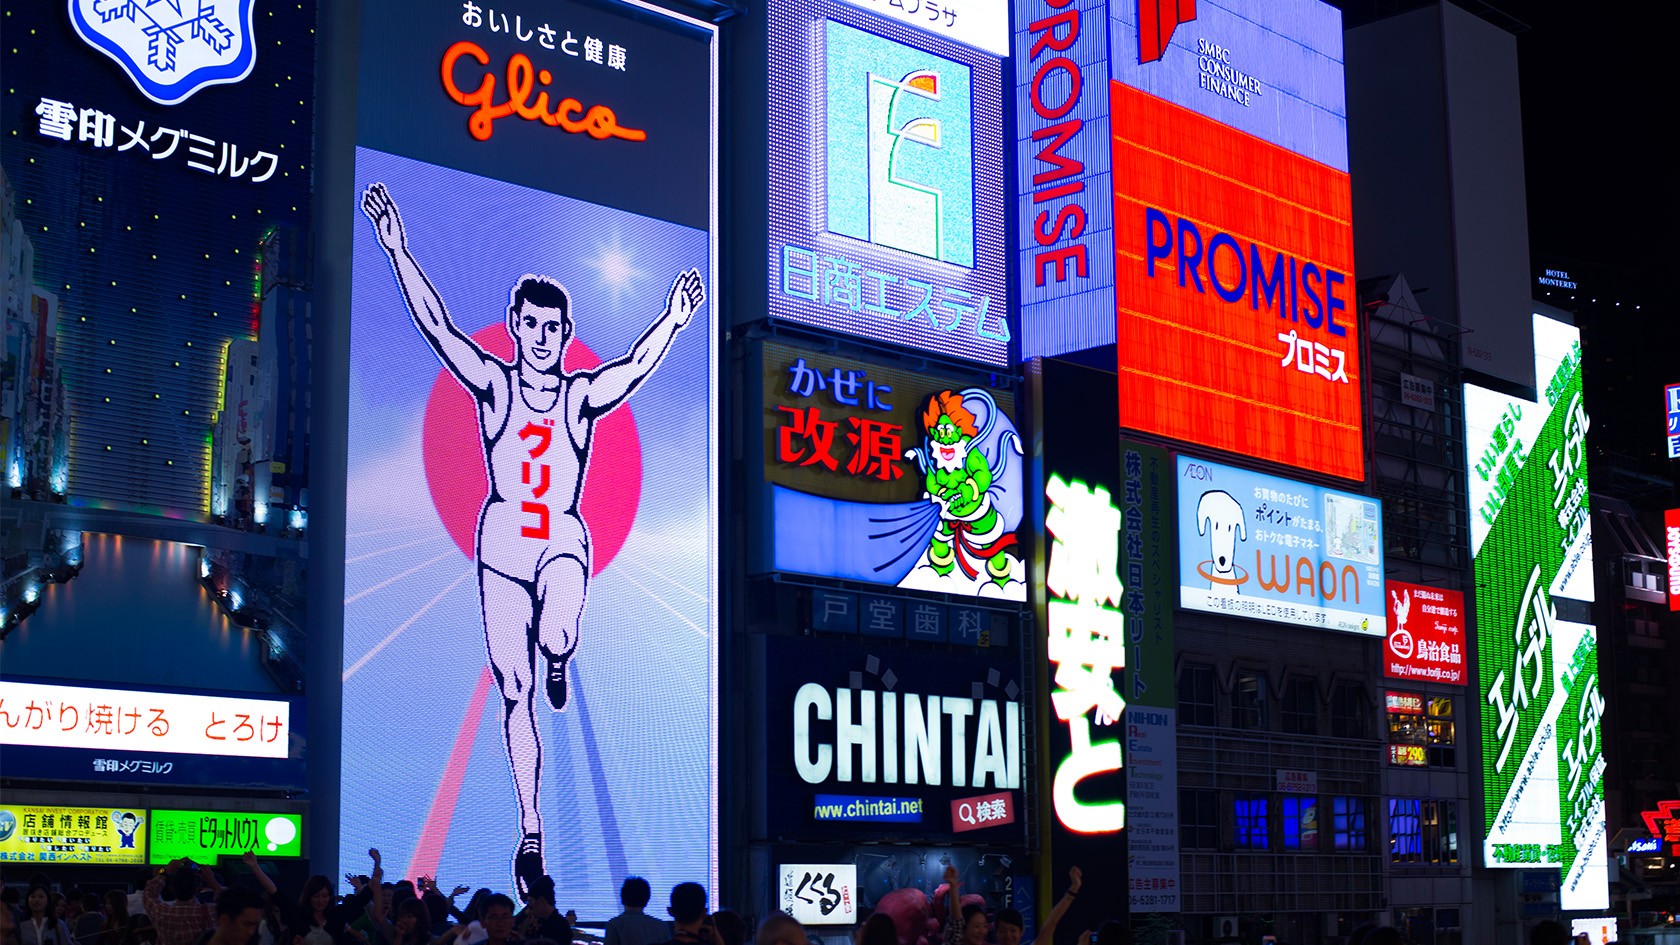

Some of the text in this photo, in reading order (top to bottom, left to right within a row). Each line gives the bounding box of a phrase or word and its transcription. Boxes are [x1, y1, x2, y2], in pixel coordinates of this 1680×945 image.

[462, 1, 627, 72] おいしさと健康
[1199, 38, 1231, 65] SMBC
[441, 41, 647, 141] Glico
[1199, 55, 1263, 96] CONSUMER
[1200, 72, 1250, 107] FINANCE
[36, 98, 278, 182] 雪印メグミルク
[1029, 0, 1088, 287] ROMISE
[1146, 207, 1346, 338] PROMISE
[1538, 277, 1578, 290] MONTEREY
[1545, 269, 1569, 279] HOTEL
[784, 245, 1011, 342] 日商エステム
[1278, 330, 1349, 384] プロミス
[789, 358, 893, 411] かぜに
[777, 404, 904, 481] 改源
[518, 418, 555, 540] グリコ
[1254, 486, 1309, 509] お買物のたびに
[1255, 528, 1320, 550] おトクな電子マネー
[1125, 450, 1147, 700] 株式会社日本リート
[205, 711, 283, 743] とろけ
[1128, 711, 1168, 727] NIHON
[1128, 725, 1148, 738] Real
[794, 682, 1020, 789] CHINTAI
[1128, 739, 1153, 752] Estate
[93, 758, 173, 775] 雪印メグミルク
[1128, 766, 1163, 781] Technology
[1129, 752, 1162, 768] Investment
[1129, 781, 1155, 790] SERVICE
[23, 813, 108, 830] 店舗情報館
[68, 808, 108, 816] CORPORATION
[976, 799, 1007, 822] 検索
[200, 816, 260, 849] ピタットハウス
[1627, 839, 1657, 852] Asahi
[795, 872, 841, 916] くくる
